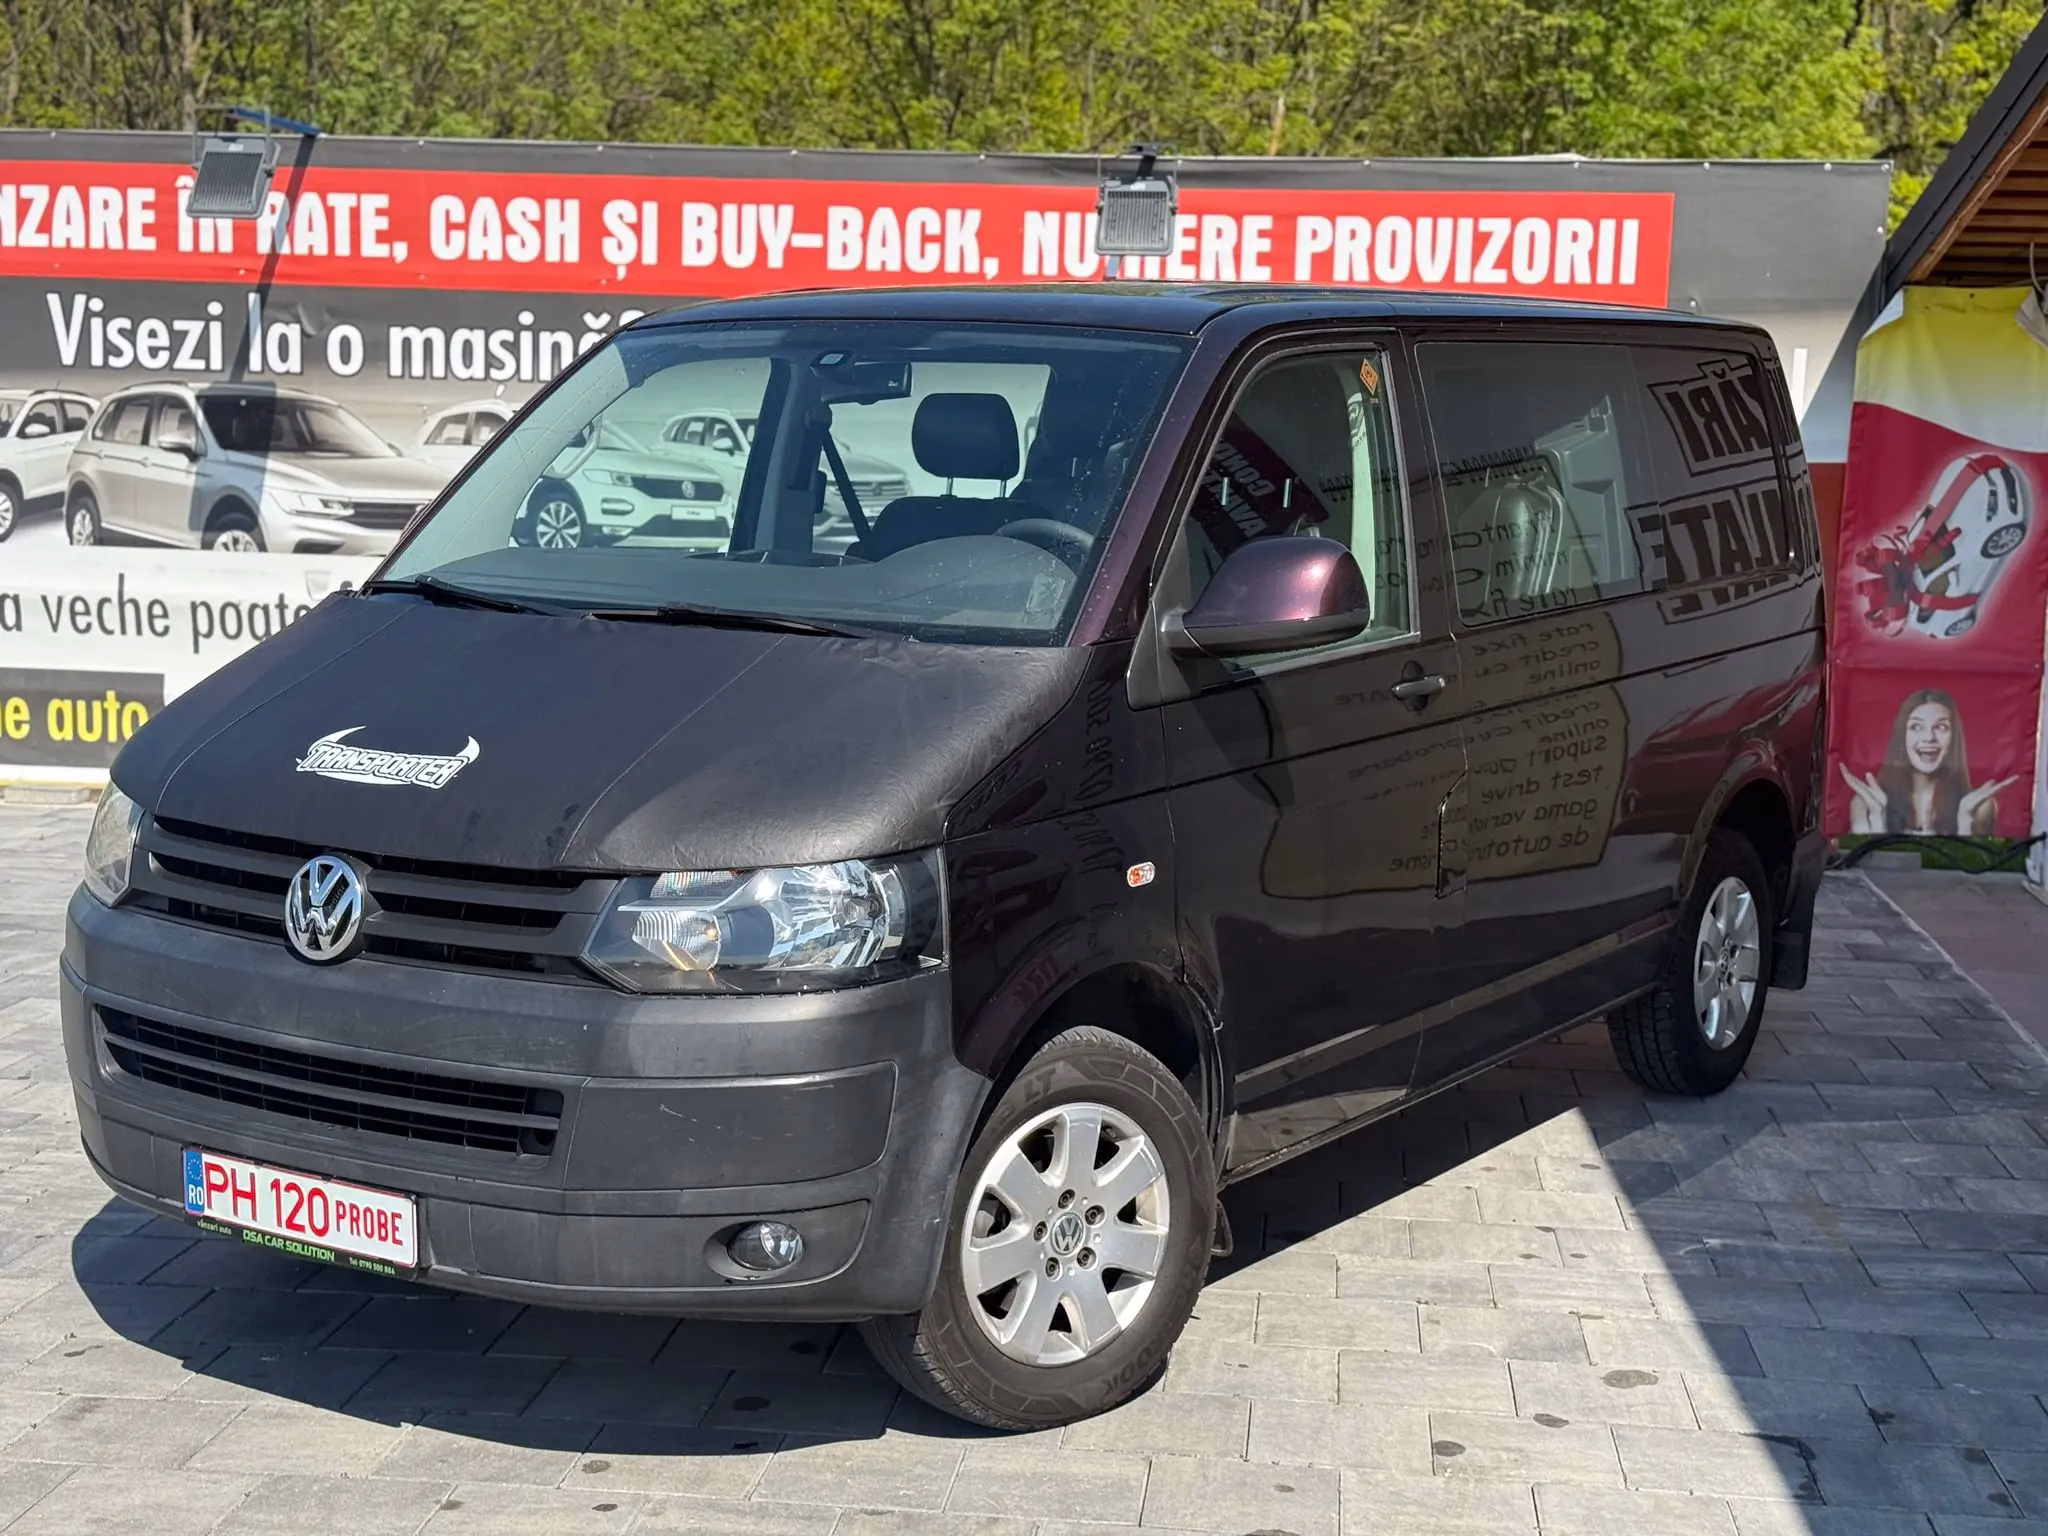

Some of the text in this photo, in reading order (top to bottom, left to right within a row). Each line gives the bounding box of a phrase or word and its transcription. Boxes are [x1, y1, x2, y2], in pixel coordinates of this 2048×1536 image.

[430, 197, 580, 264] CASH
[602, 201, 657, 280] ȘI
[1022, 211, 1273, 282] NUERE
[1295, 214, 1640, 286] PROVIZORII
[46, 292, 225, 372] Visezi
[248, 291, 303, 375] la
[326, 323, 365, 377] o
[41, 572, 170, 638] veche
[299, 742, 466, 788] TRANSPORTER
[188, 1184, 204, 1206] RO
[204, 1161, 404, 1247] PH 120 PROBE
[265, 1235, 285, 1250] CAR
[285, 1240, 335, 1262] SOLUTION
